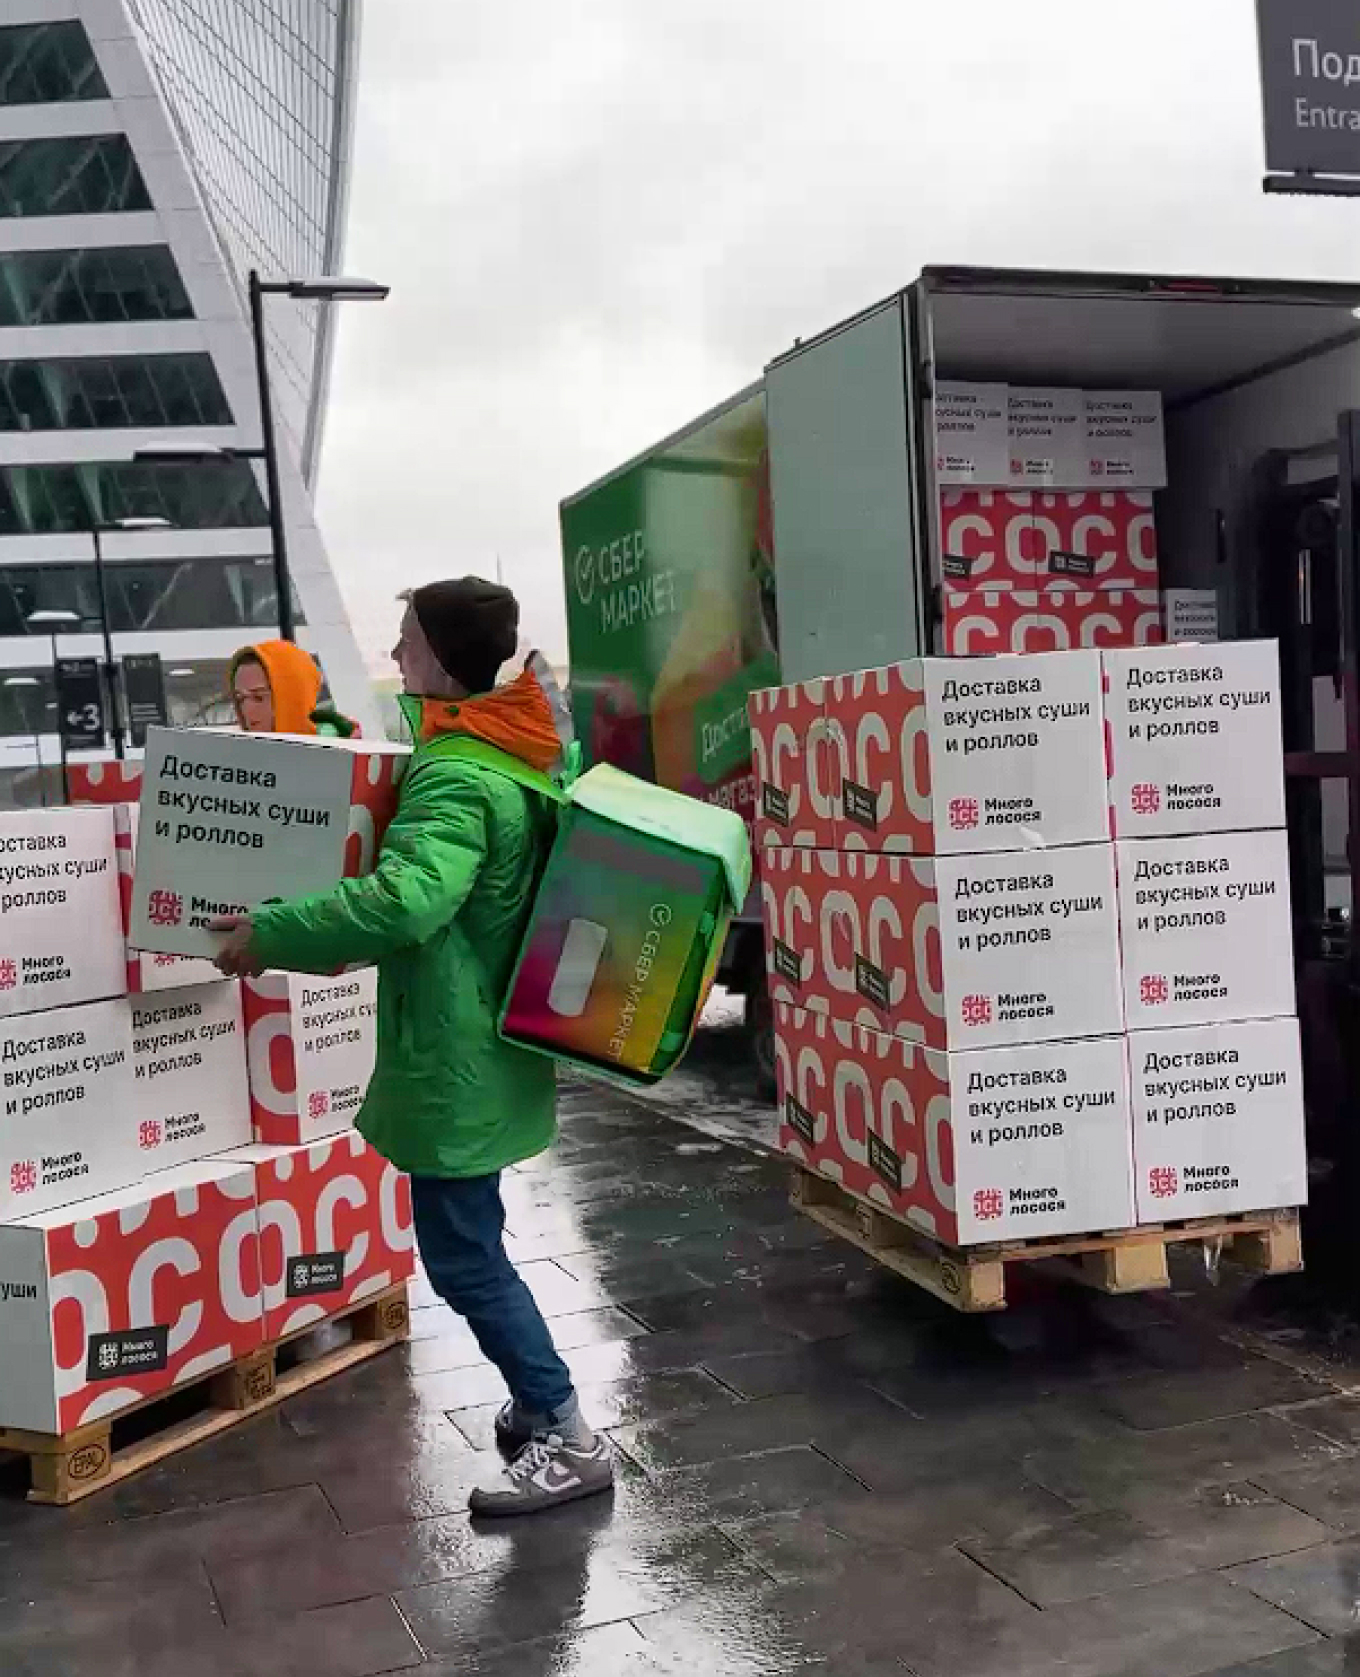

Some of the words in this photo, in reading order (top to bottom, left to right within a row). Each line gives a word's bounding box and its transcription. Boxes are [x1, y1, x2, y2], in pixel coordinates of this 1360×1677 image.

[1296, 97, 1360, 130] Entra
[599, 530, 645, 584] СБЕР
[942, 678, 1041, 702] Доставка
[1126, 666, 1223, 690] Доставка
[944, 706, 1032, 729] вкусных
[1037, 702, 1089, 722] суши
[1128, 694, 1213, 715] вкусных
[1219, 691, 1270, 710] суши
[946, 739, 958, 752] и
[964, 732, 1038, 755] роллов
[1129, 725, 1141, 739] и
[1147, 720, 1219, 742] роллов
[160, 755, 276, 788] Доставка
[158, 790, 260, 818] вкусных
[268, 804, 330, 827] суши
[0, 835, 66, 852] оставка
[155, 820, 170, 837] и
[176, 824, 263, 848] роллов
[0, 863, 60, 885] усных
[65, 858, 107, 879] суши
[1134, 858, 1229, 882] Доставка
[955, 874, 1053, 900] Доставка
[1136, 885, 1220, 907] вкусных
[1225, 881, 1275, 900] суши
[2, 890, 67, 913] роллов
[957, 902, 1044, 925] вкусных
[1050, 896, 1103, 918] суши
[1138, 917, 1148, 930] и
[1154, 910, 1226, 933] роллов
[958, 936, 970, 950] и
[976, 928, 1051, 952] роллов
[22, 956, 64, 972] Много
[132, 1001, 203, 1030] Доставка
[2, 1031, 87, 1064] Доставка
[133, 1028, 197, 1054] вкусных
[199, 1019, 235, 1041] суши
[2, 1053, 80, 1088] вкусных
[83, 1050, 125, 1073] суши
[135, 1065, 145, 1078] и
[148, 1052, 202, 1079] роллов
[1143, 1050, 1239, 1074] Доставка
[967, 1068, 1067, 1094] Доставка
[1145, 1076, 1230, 1098] вкусных
[1235, 1071, 1286, 1092] суши
[6, 1100, 17, 1115] и
[22, 1086, 85, 1115] роллов
[969, 1096, 1057, 1119] вкусных
[1063, 1091, 1115, 1112] суши
[1147, 1109, 1158, 1123] и
[1164, 1102, 1236, 1124] роллов
[971, 1129, 983, 1144] и
[989, 1122, 1064, 1146] роллов
[1, 1281, 37, 1302] уши
